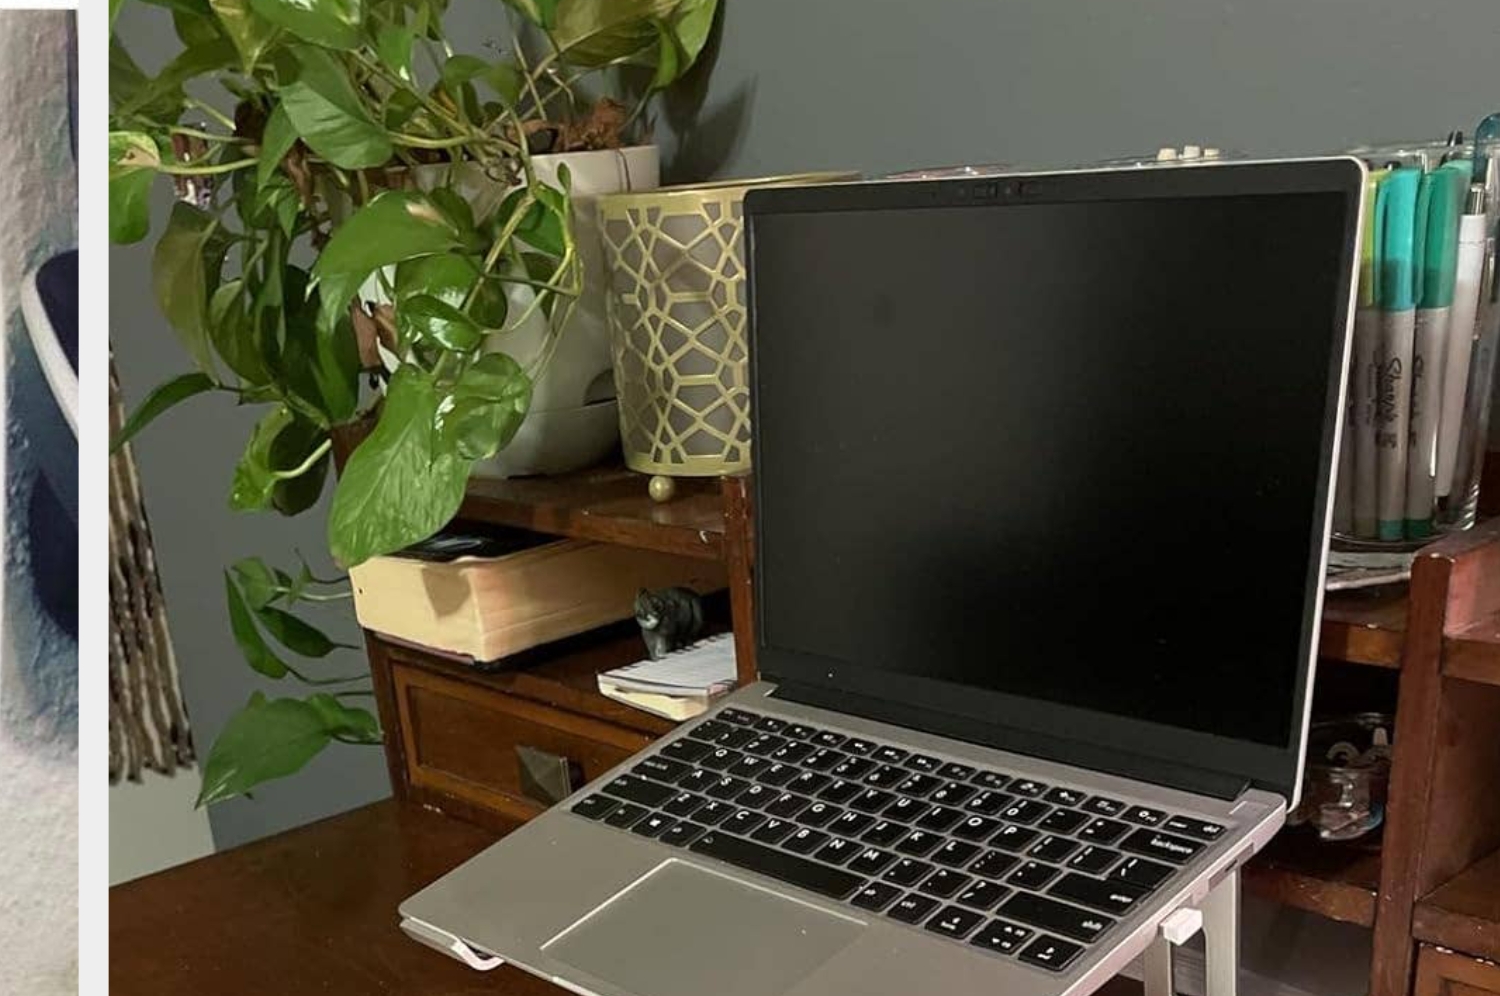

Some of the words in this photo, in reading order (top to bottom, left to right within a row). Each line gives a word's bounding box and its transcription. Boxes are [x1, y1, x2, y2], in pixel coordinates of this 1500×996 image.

[720, 776, 732, 786] S
[833, 780, 845, 789] T
[749, 784, 762, 794] D
[866, 789, 878, 798] Y
[706, 801, 719, 810] X
[897, 798, 911, 807] U
[811, 803, 826, 813] G
[736, 810, 750, 820] C
[842, 812, 858, 822] H
[768, 820, 781, 829] V
[875, 822, 888, 831] J
[796, 829, 810, 838] B
[1004, 825, 1018, 835] P
[910, 831, 924, 841] K
[829, 838, 846, 849] N
[946, 841, 957, 851] L
[862, 850, 880, 860] M
